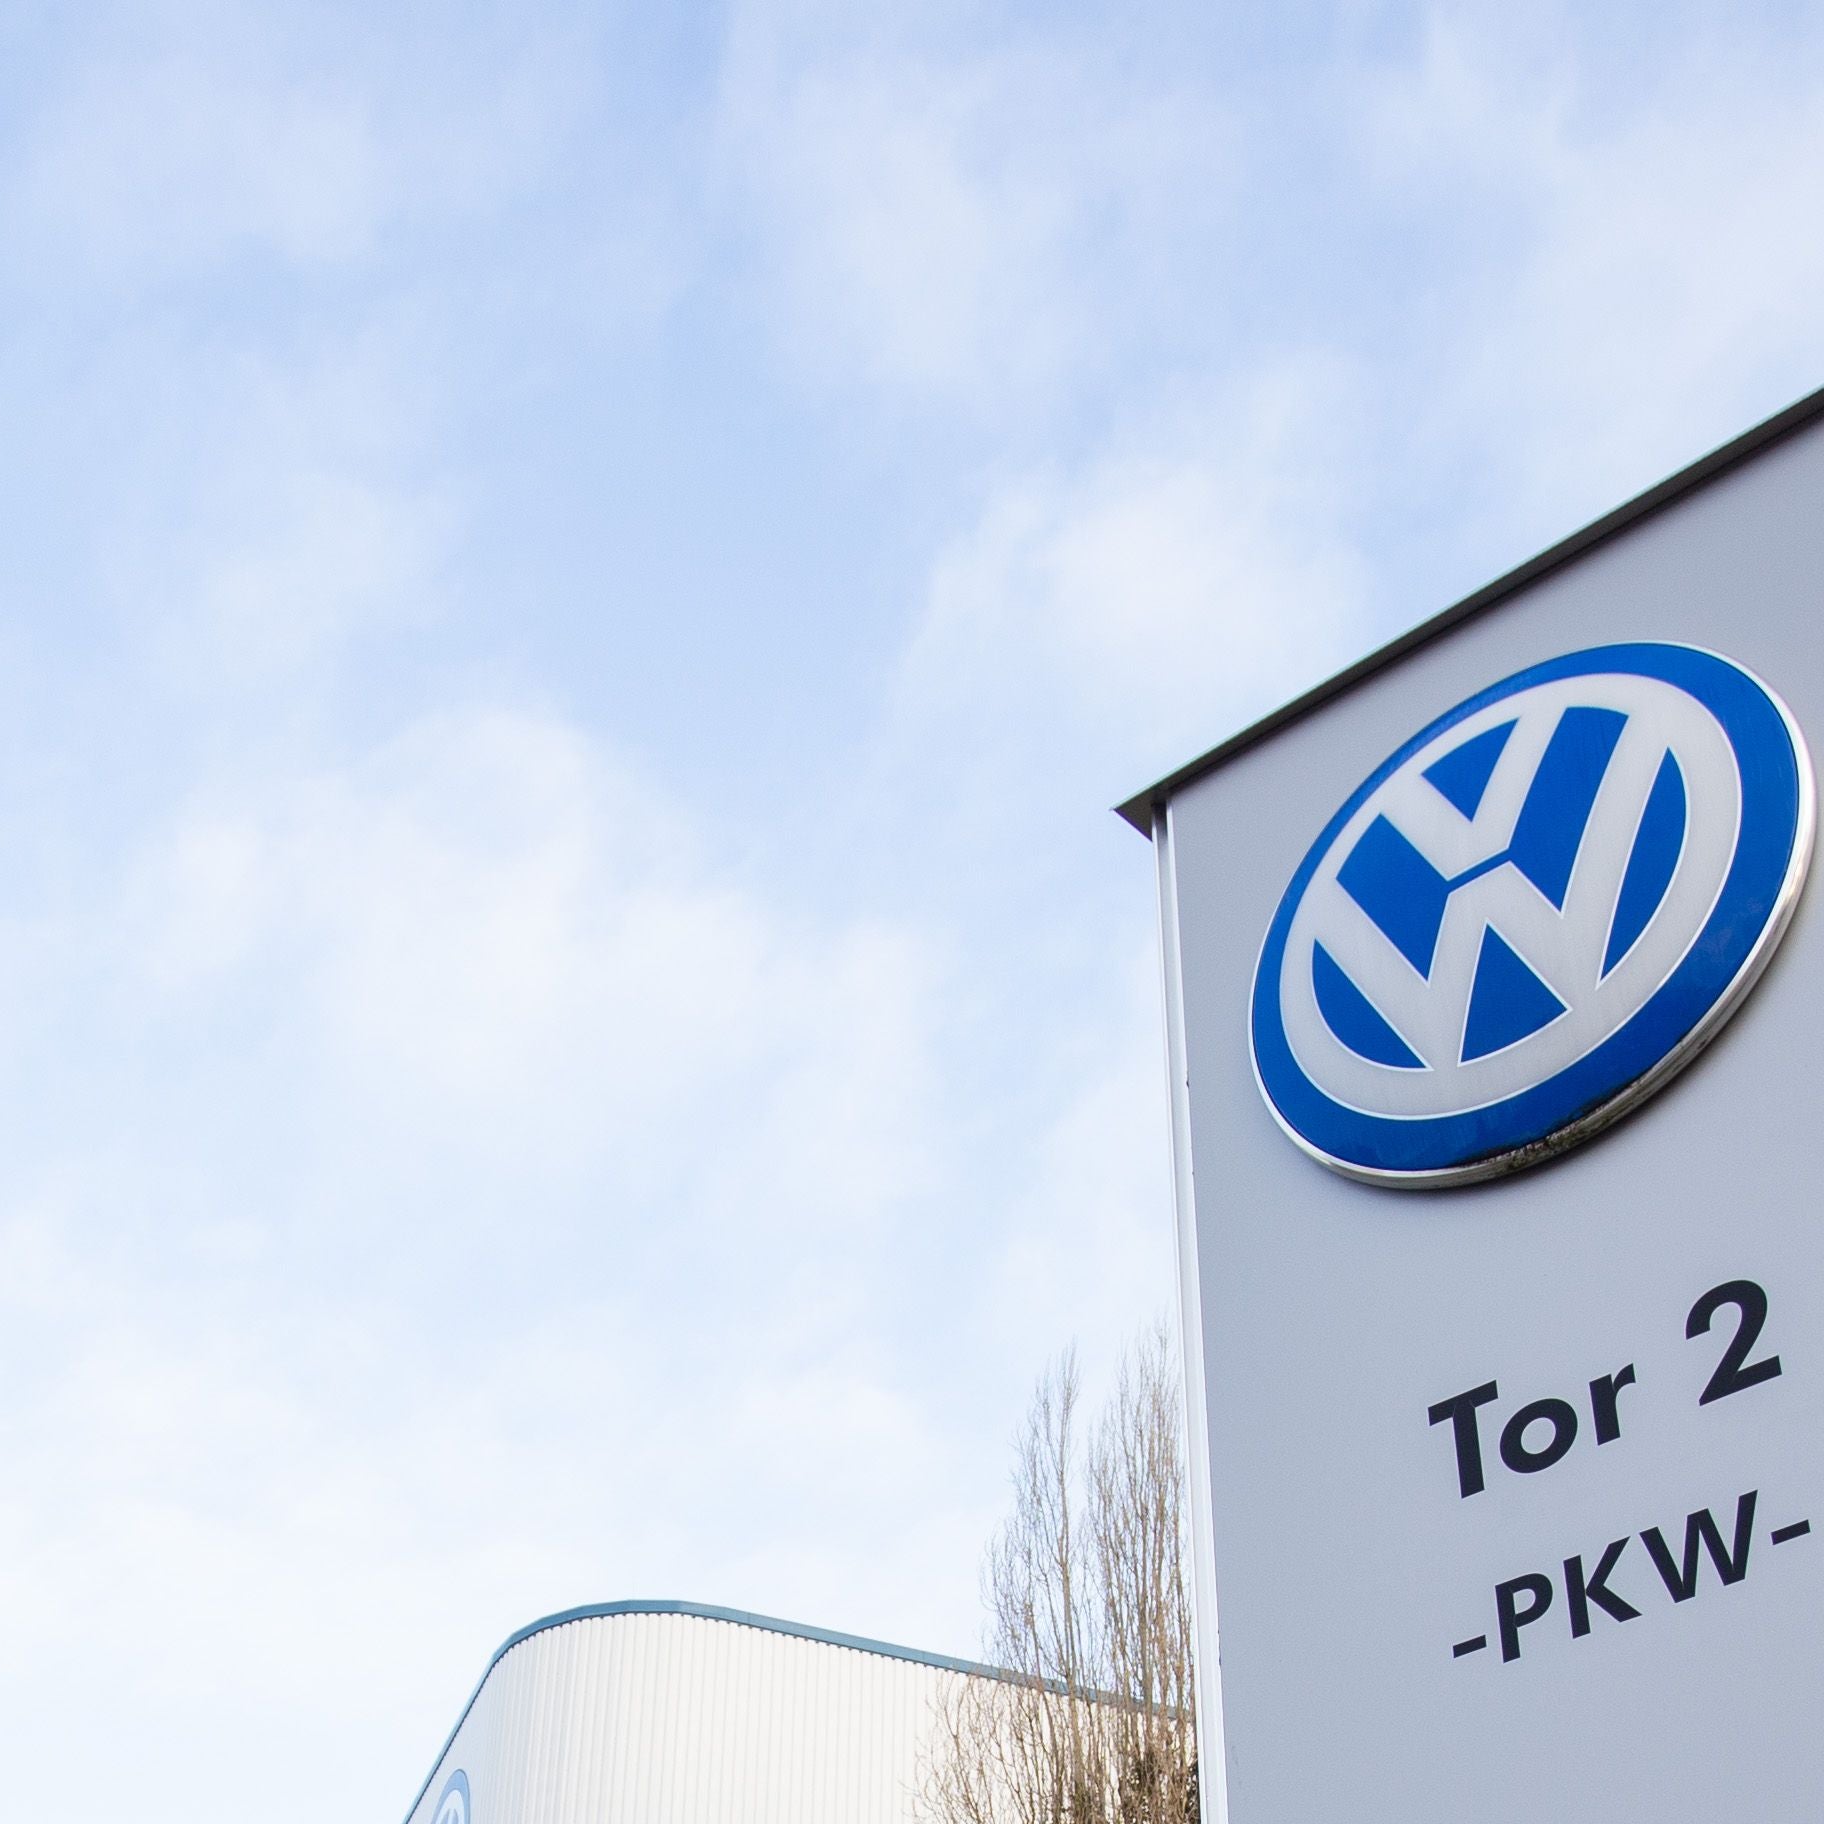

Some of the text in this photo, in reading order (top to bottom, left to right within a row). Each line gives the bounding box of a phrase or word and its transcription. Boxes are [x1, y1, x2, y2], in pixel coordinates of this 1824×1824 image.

[1280, 673, 1742, 1119] VW
[1427, 1279, 1783, 1499] Tor 2
[1452, 1489, 1811, 1664] -PKW-
